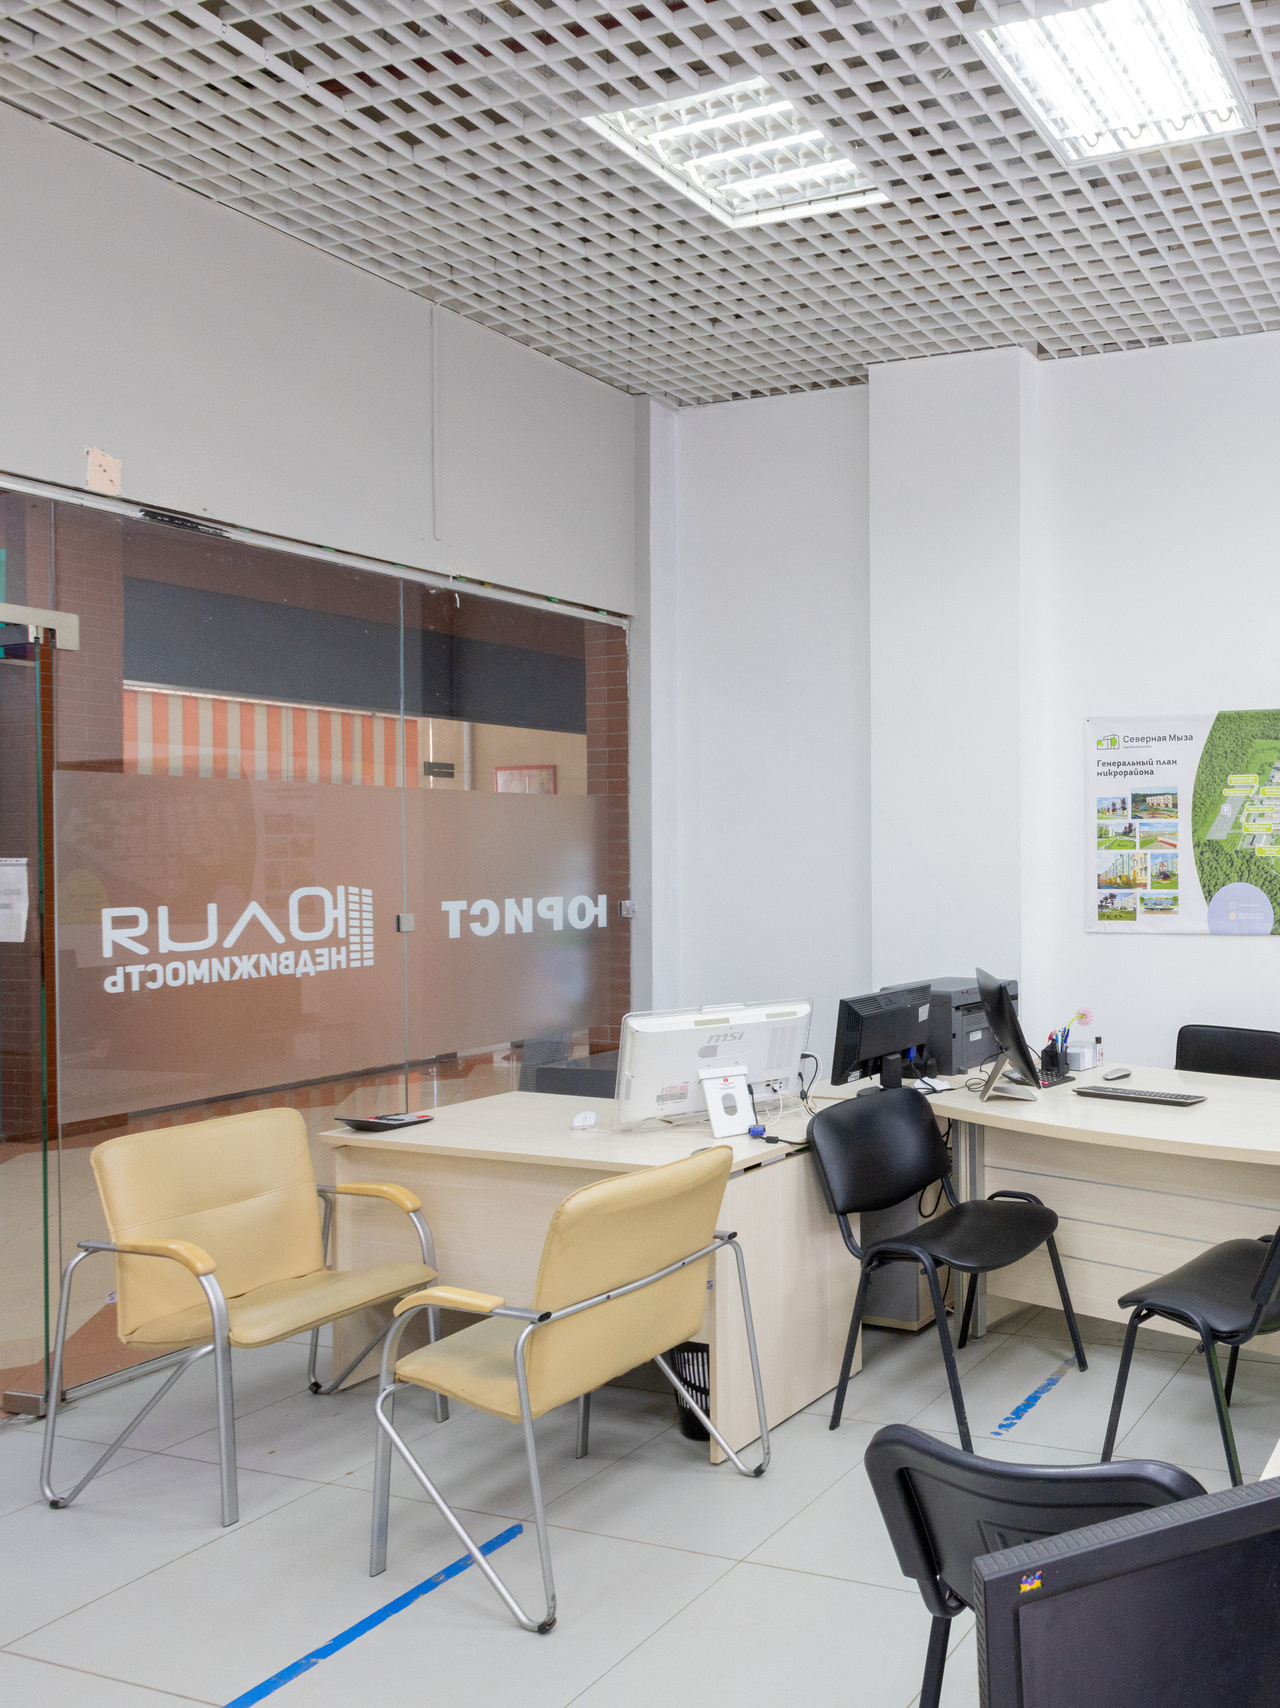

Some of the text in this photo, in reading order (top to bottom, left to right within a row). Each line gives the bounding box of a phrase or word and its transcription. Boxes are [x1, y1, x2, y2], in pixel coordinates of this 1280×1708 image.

[1123, 734, 1194, 745] Северная Мыза
[1097, 758, 1154, 768] Генеральный
[1097, 768, 1155, 778] микрорайона
[706, 1031, 747, 1044] msi
